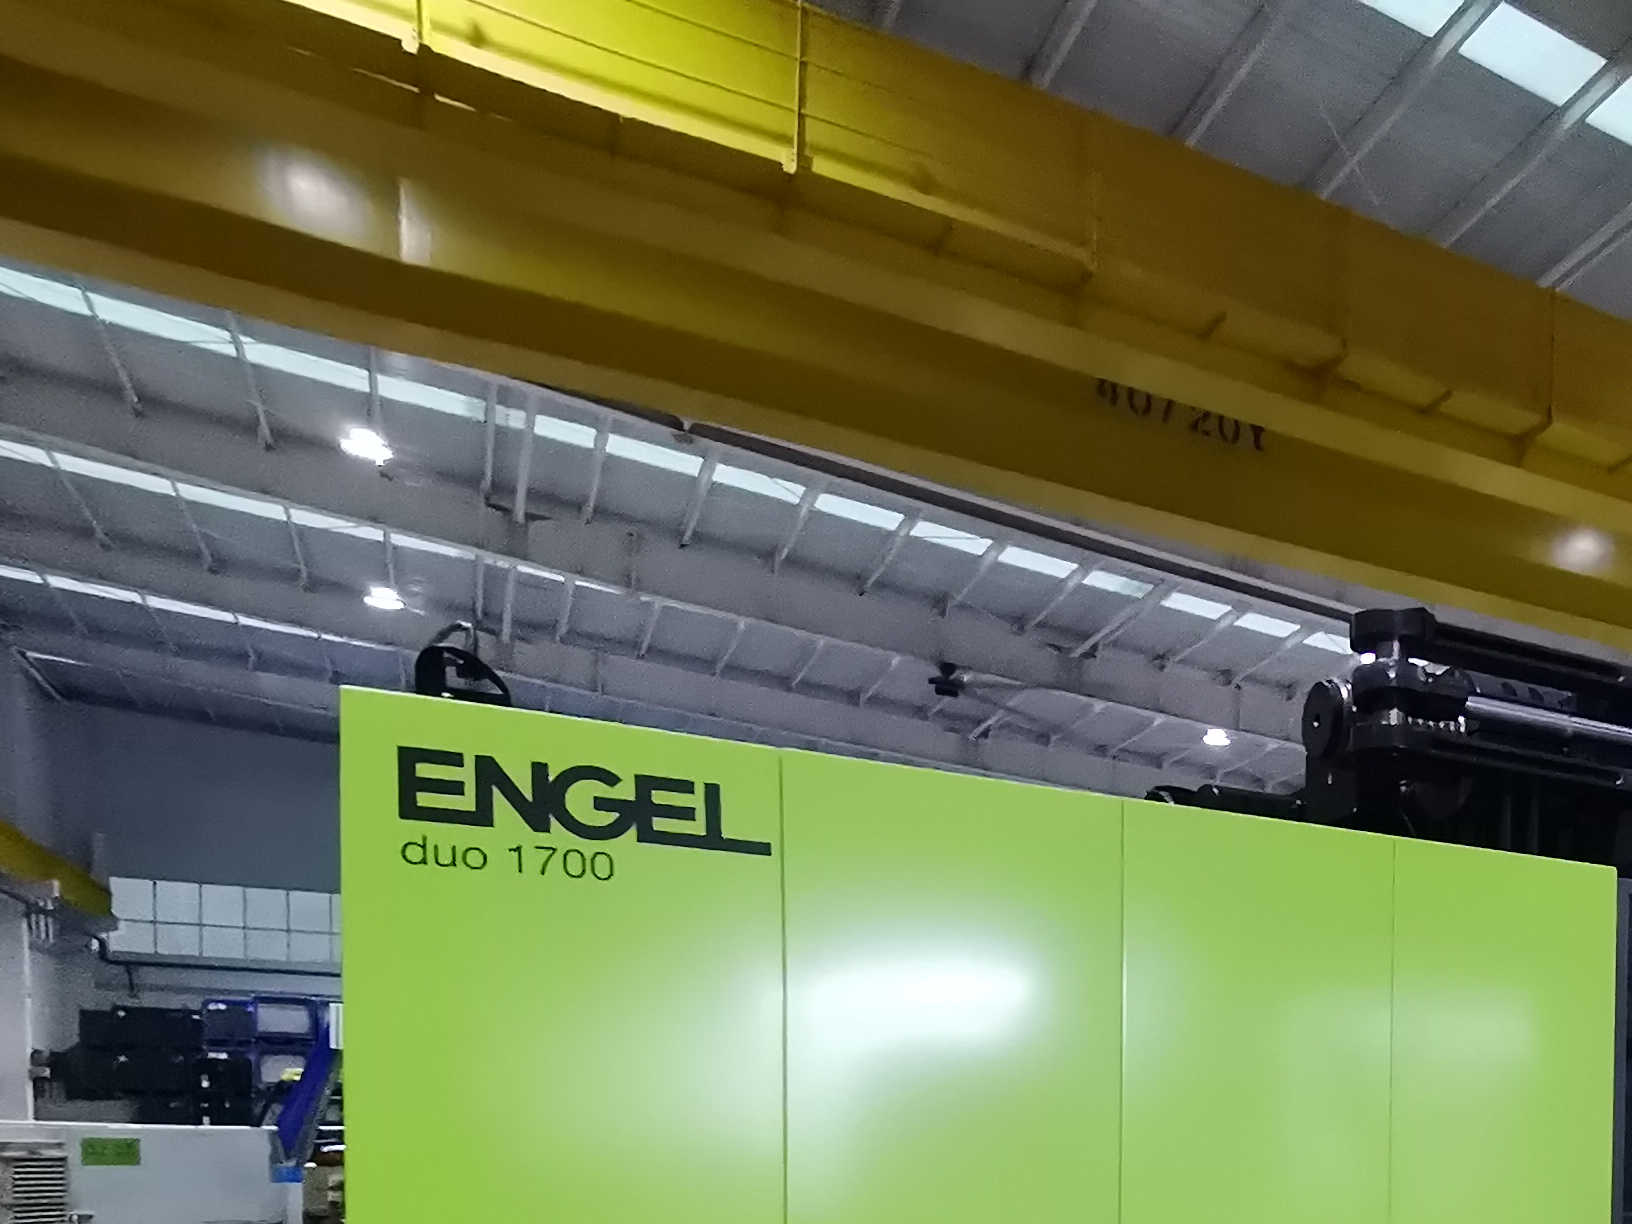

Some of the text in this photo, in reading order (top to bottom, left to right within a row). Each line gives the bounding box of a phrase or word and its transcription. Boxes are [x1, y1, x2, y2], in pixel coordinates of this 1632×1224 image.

[396, 744, 772, 858] ENGEL
[400, 834, 615, 882] duo 1700
